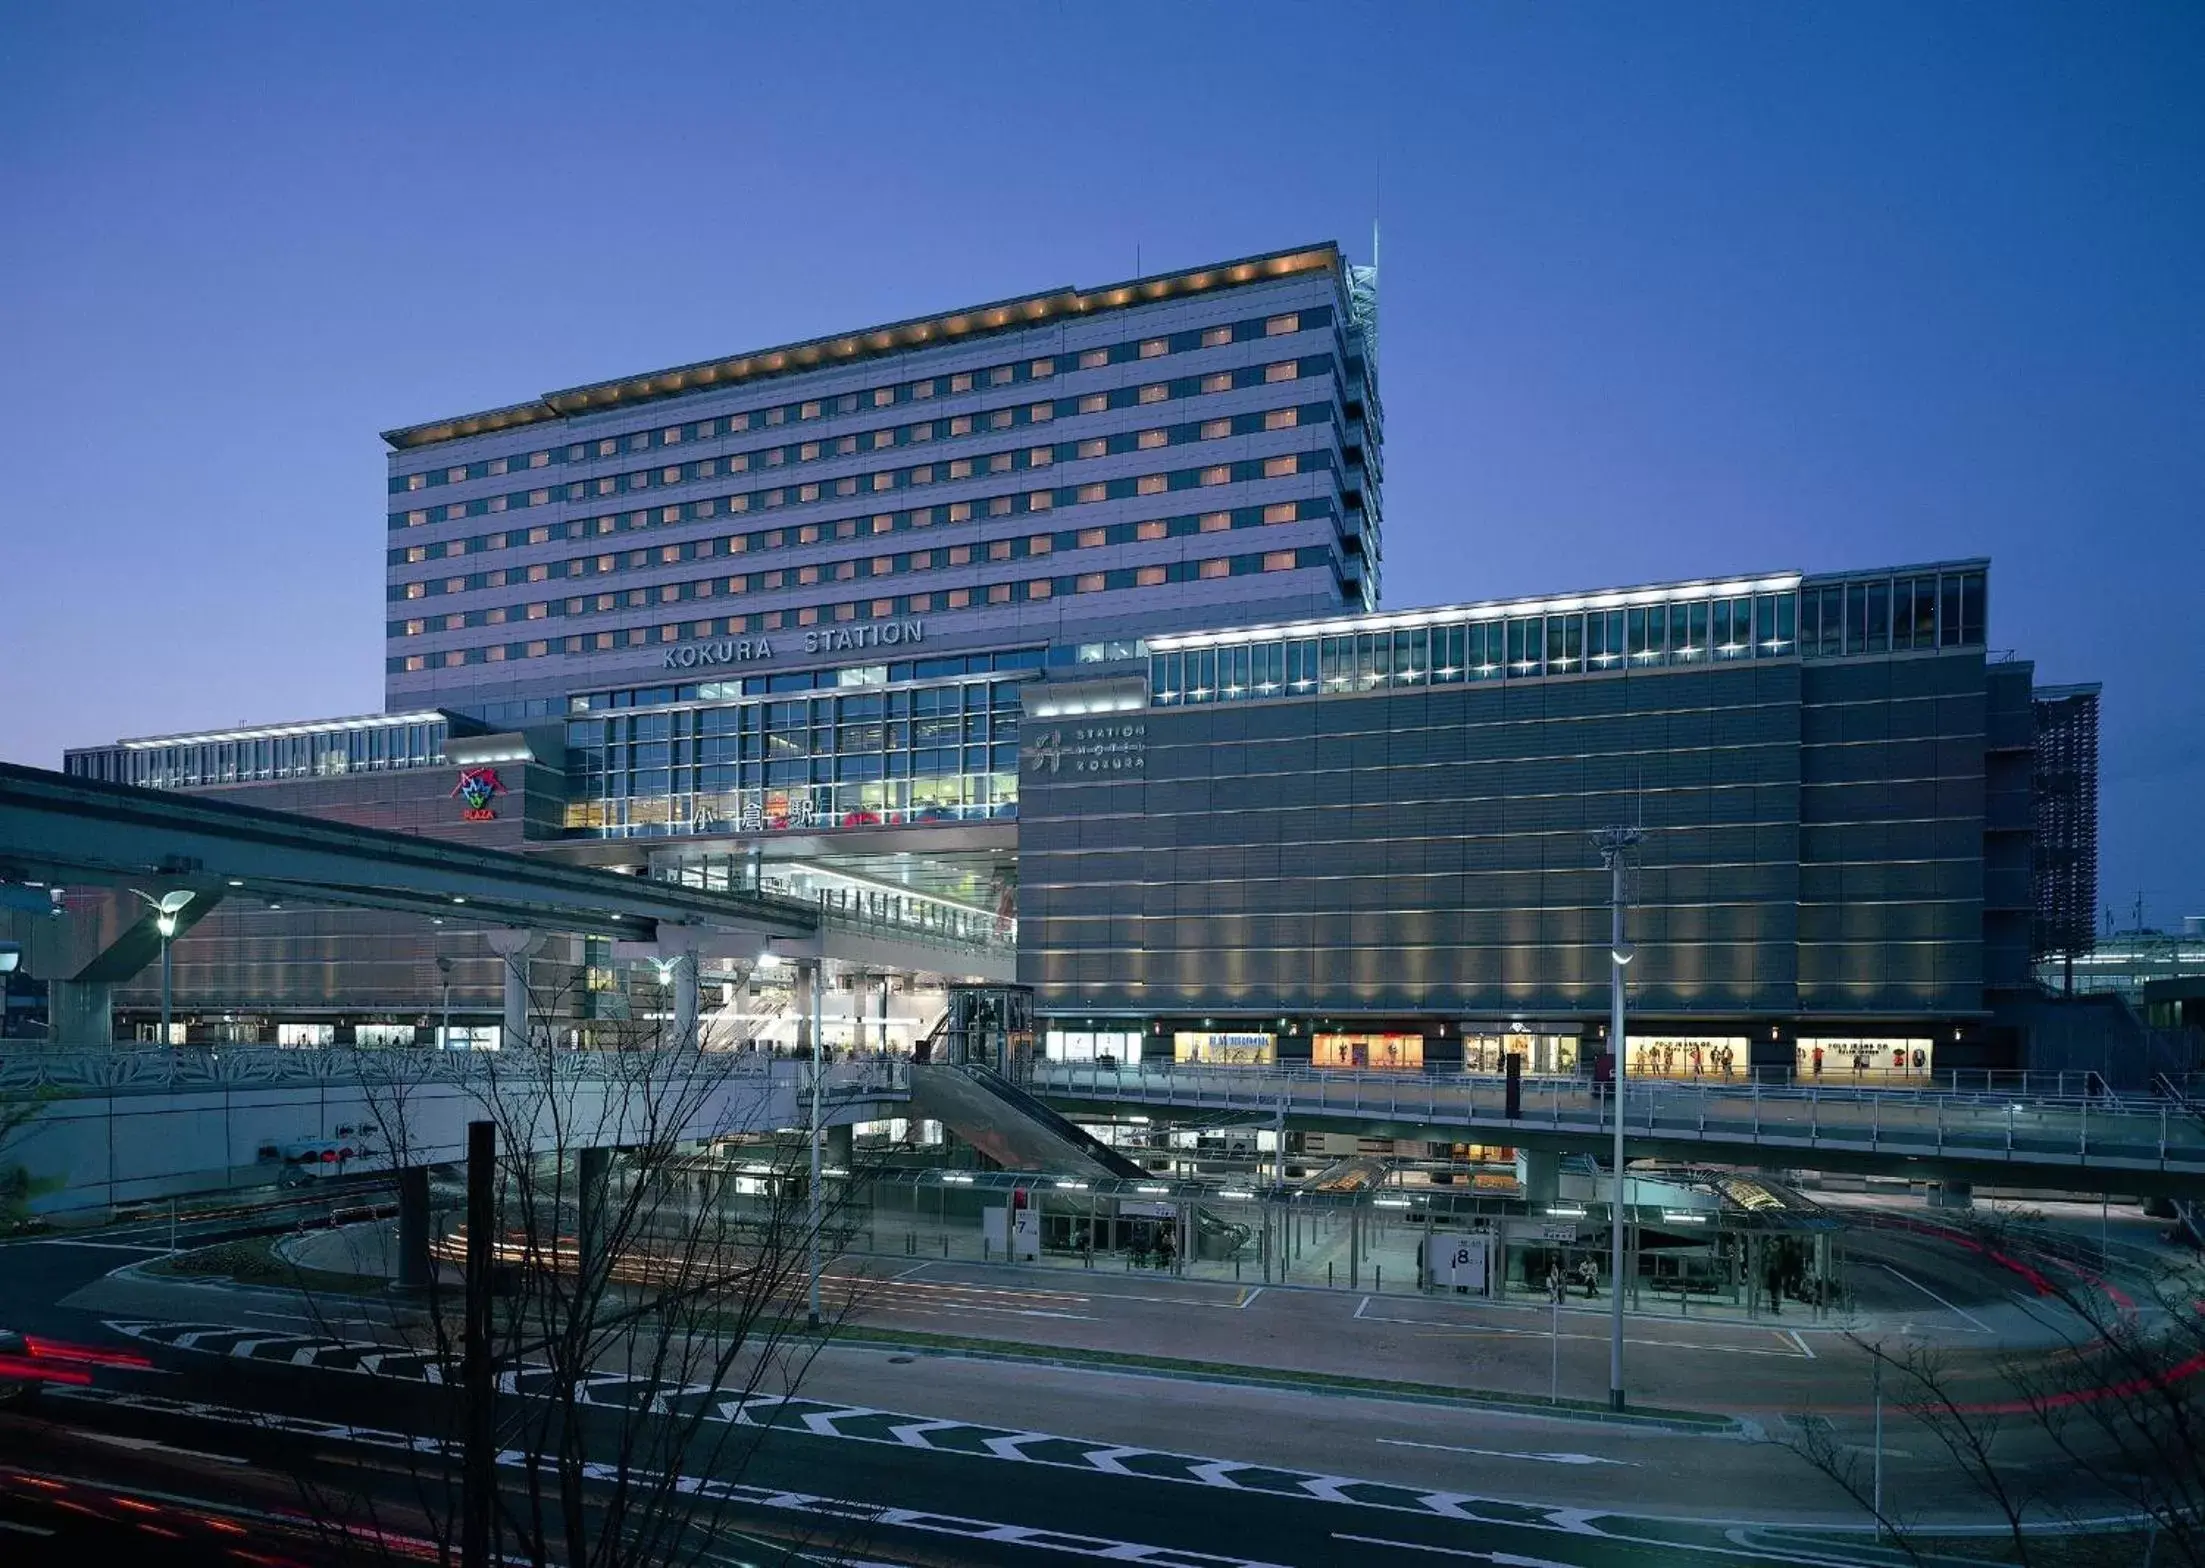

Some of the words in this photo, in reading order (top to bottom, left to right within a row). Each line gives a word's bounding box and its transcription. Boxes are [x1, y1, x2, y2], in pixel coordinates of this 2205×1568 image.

[663, 639, 773, 668] KOKURA
[804, 620, 923, 653] STATION
[1076, 725, 1145, 739] STATION
[1076, 757, 1145, 772] KOKURA
[464, 808, 494, 820] PLAZA
[693, 799, 814, 831] 小倉駅
[1017, 1221, 1026, 1233] 7
[1457, 1249, 1469, 1264] 8
